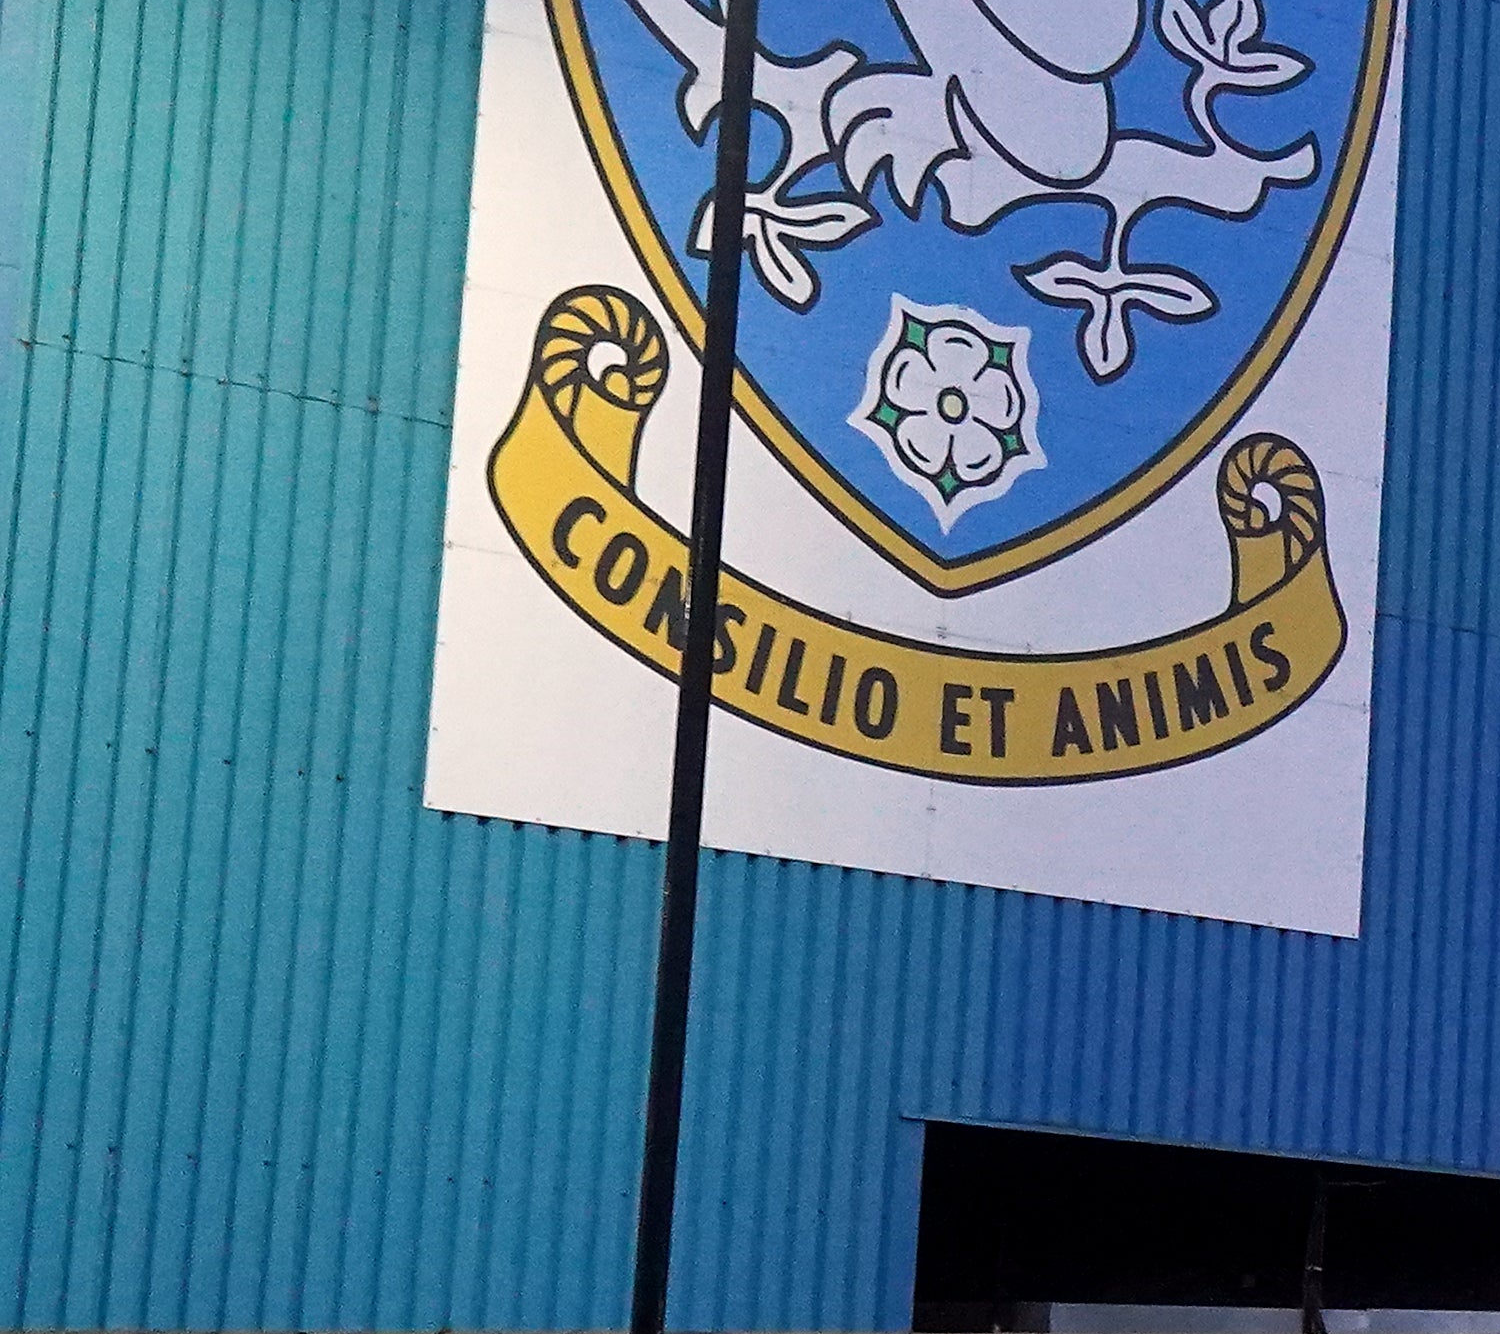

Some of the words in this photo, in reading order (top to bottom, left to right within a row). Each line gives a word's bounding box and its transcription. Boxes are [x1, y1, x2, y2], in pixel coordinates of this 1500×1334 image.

[551, 496, 899, 740] CONSILIO
[940, 685, 1015, 757] ET
[1052, 621, 1291, 758] ANIMIS
